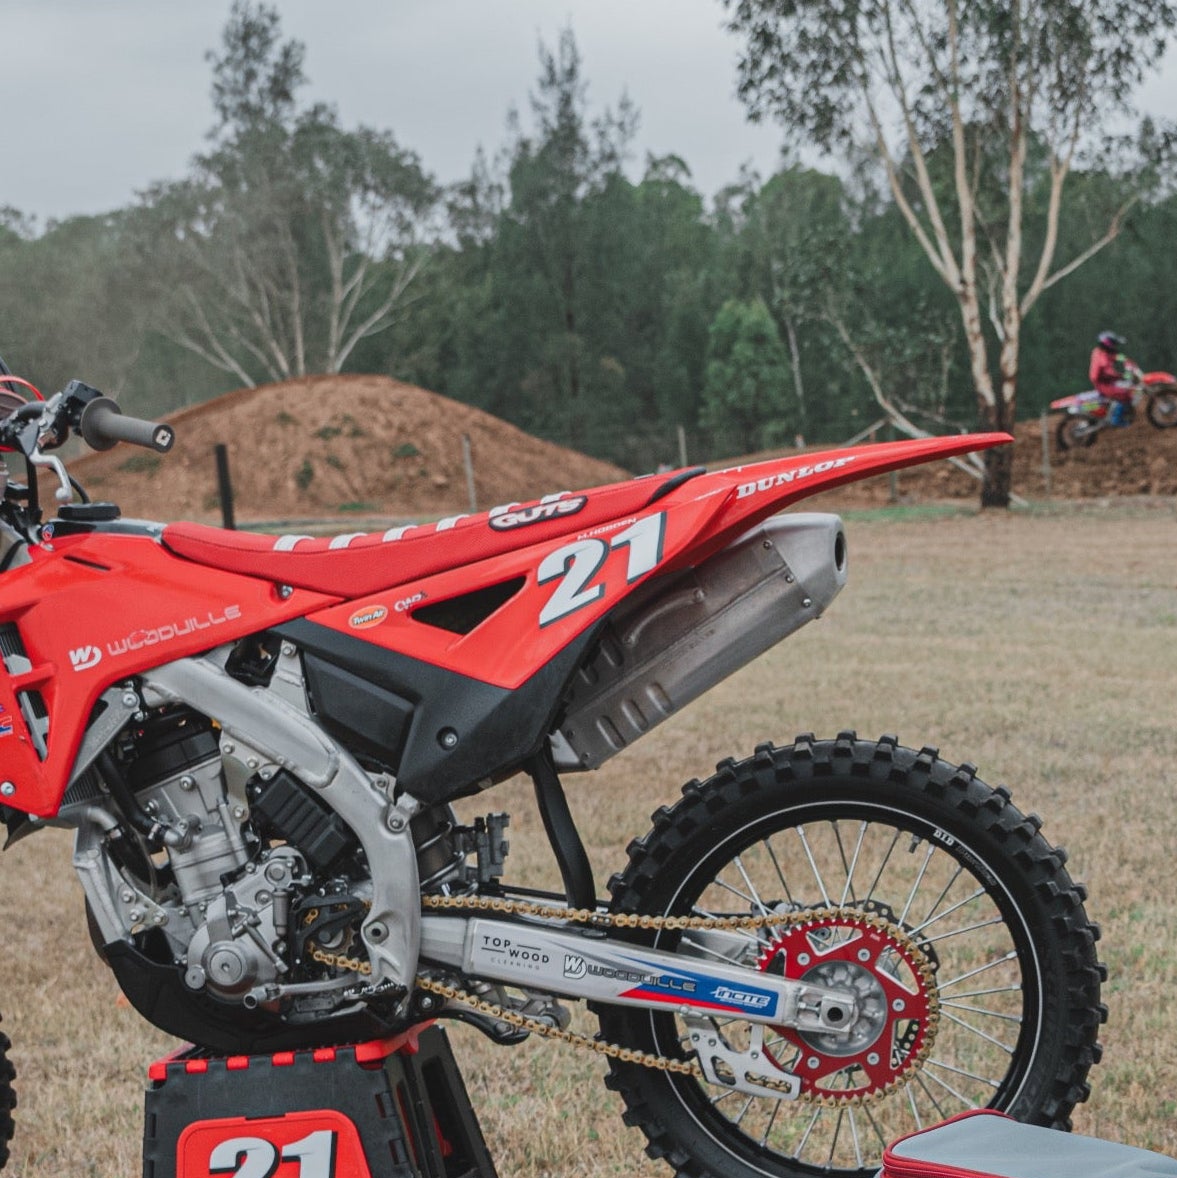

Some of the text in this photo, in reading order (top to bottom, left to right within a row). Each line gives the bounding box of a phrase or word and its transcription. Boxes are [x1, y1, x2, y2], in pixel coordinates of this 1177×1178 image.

[736, 456, 856, 499] DUNLOP
[491, 498, 583, 528] GUTS
[537, 511, 667, 629] 21
[483, 935, 511, 948] TOP
[509, 948, 550, 964] WOOD
